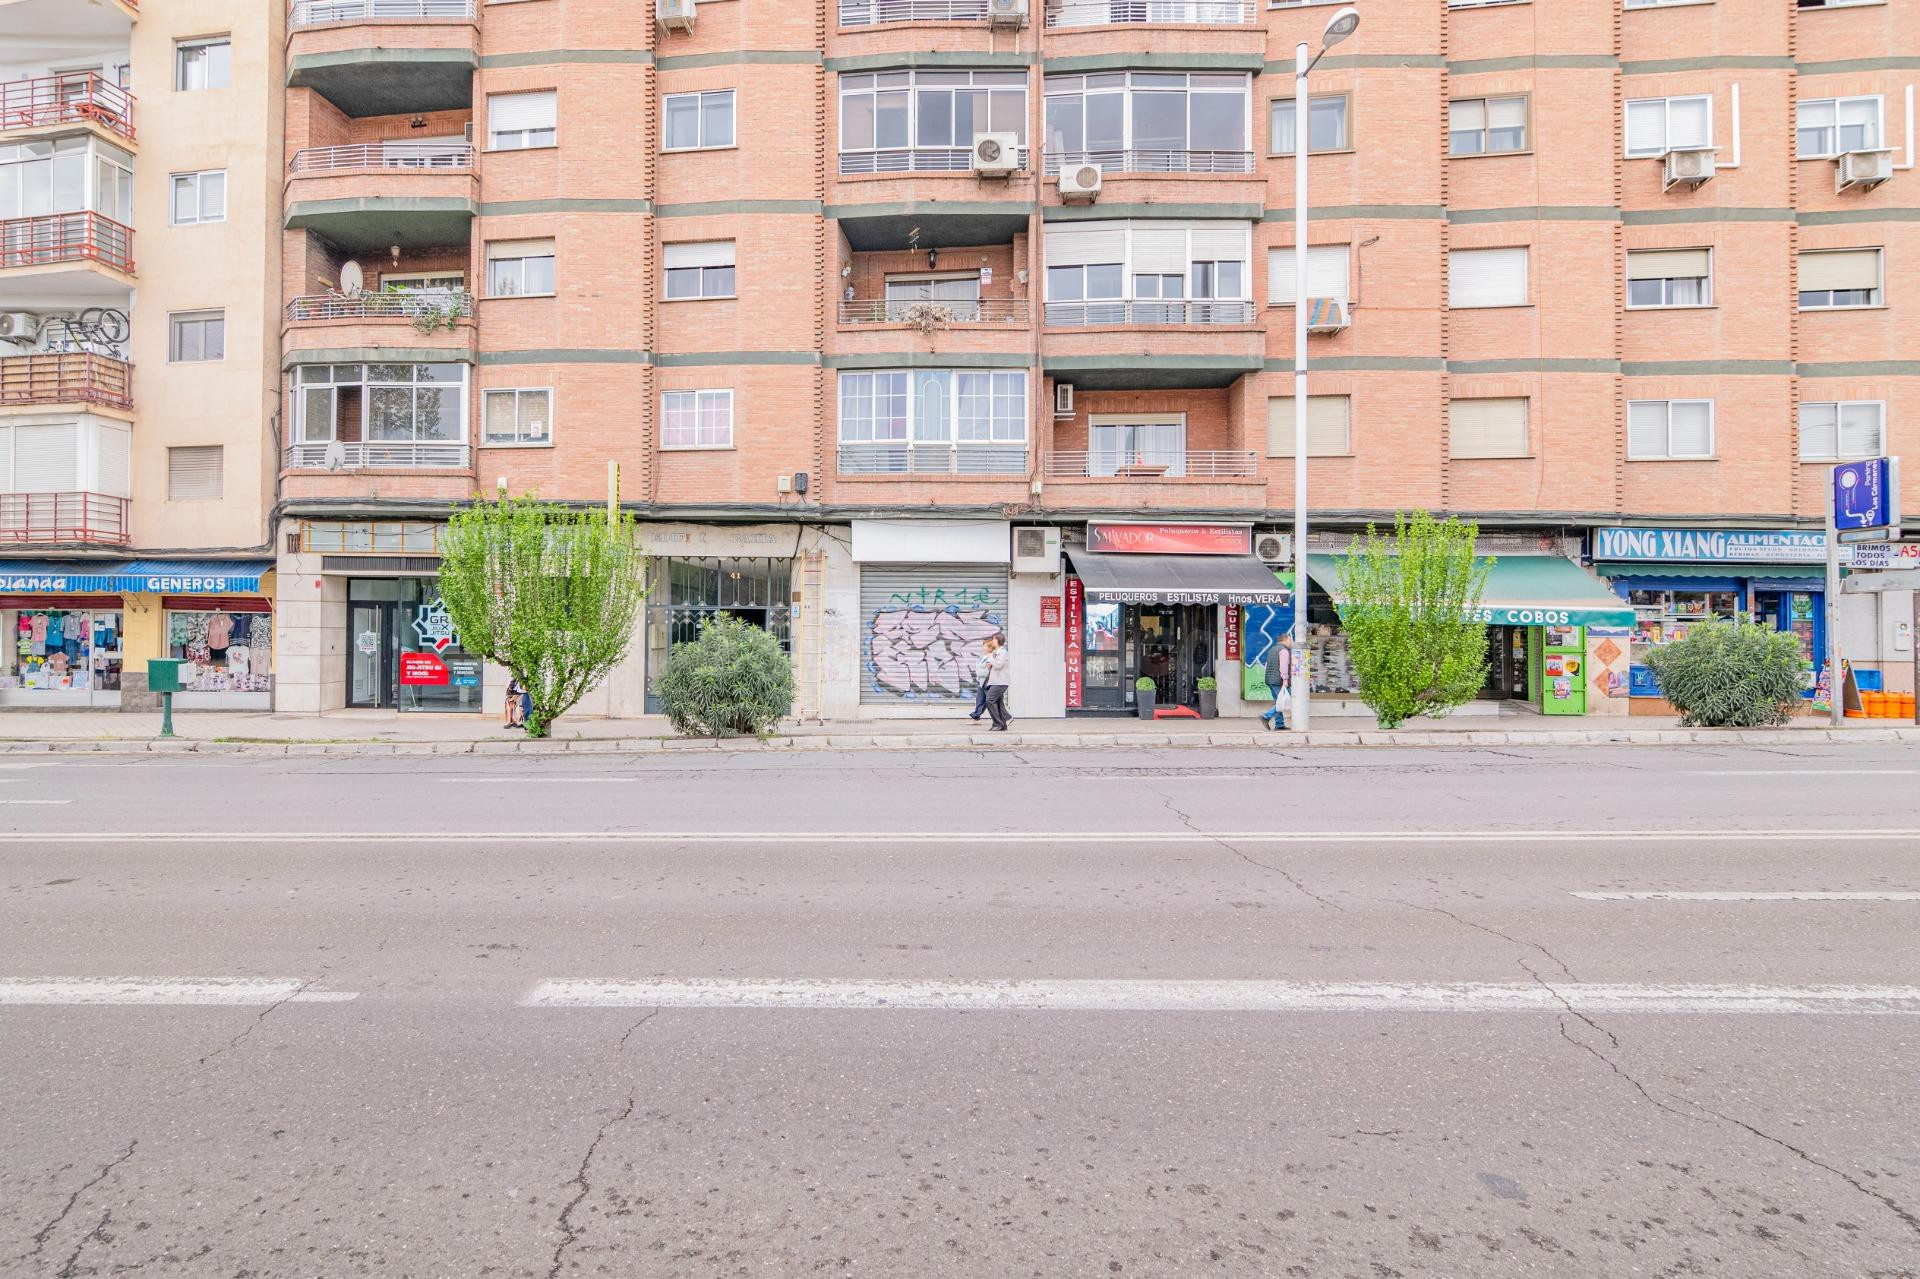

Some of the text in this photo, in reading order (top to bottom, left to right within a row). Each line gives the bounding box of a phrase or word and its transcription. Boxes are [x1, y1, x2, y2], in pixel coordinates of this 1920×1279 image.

[1601, 530, 1724, 558] YONG XIANG
[1901, 545, 1920, 558] AS
[148, 577, 226, 590] GENEROS
[1099, 592, 1158, 601] PELUQUEROS
[1167, 593, 1219, 602] ESTILISTAS
[1068, 580, 1079, 649] ESTILISTA
[1507, 610, 1569, 624] COBOS
[1068, 658, 1079, 705] UNISEX
